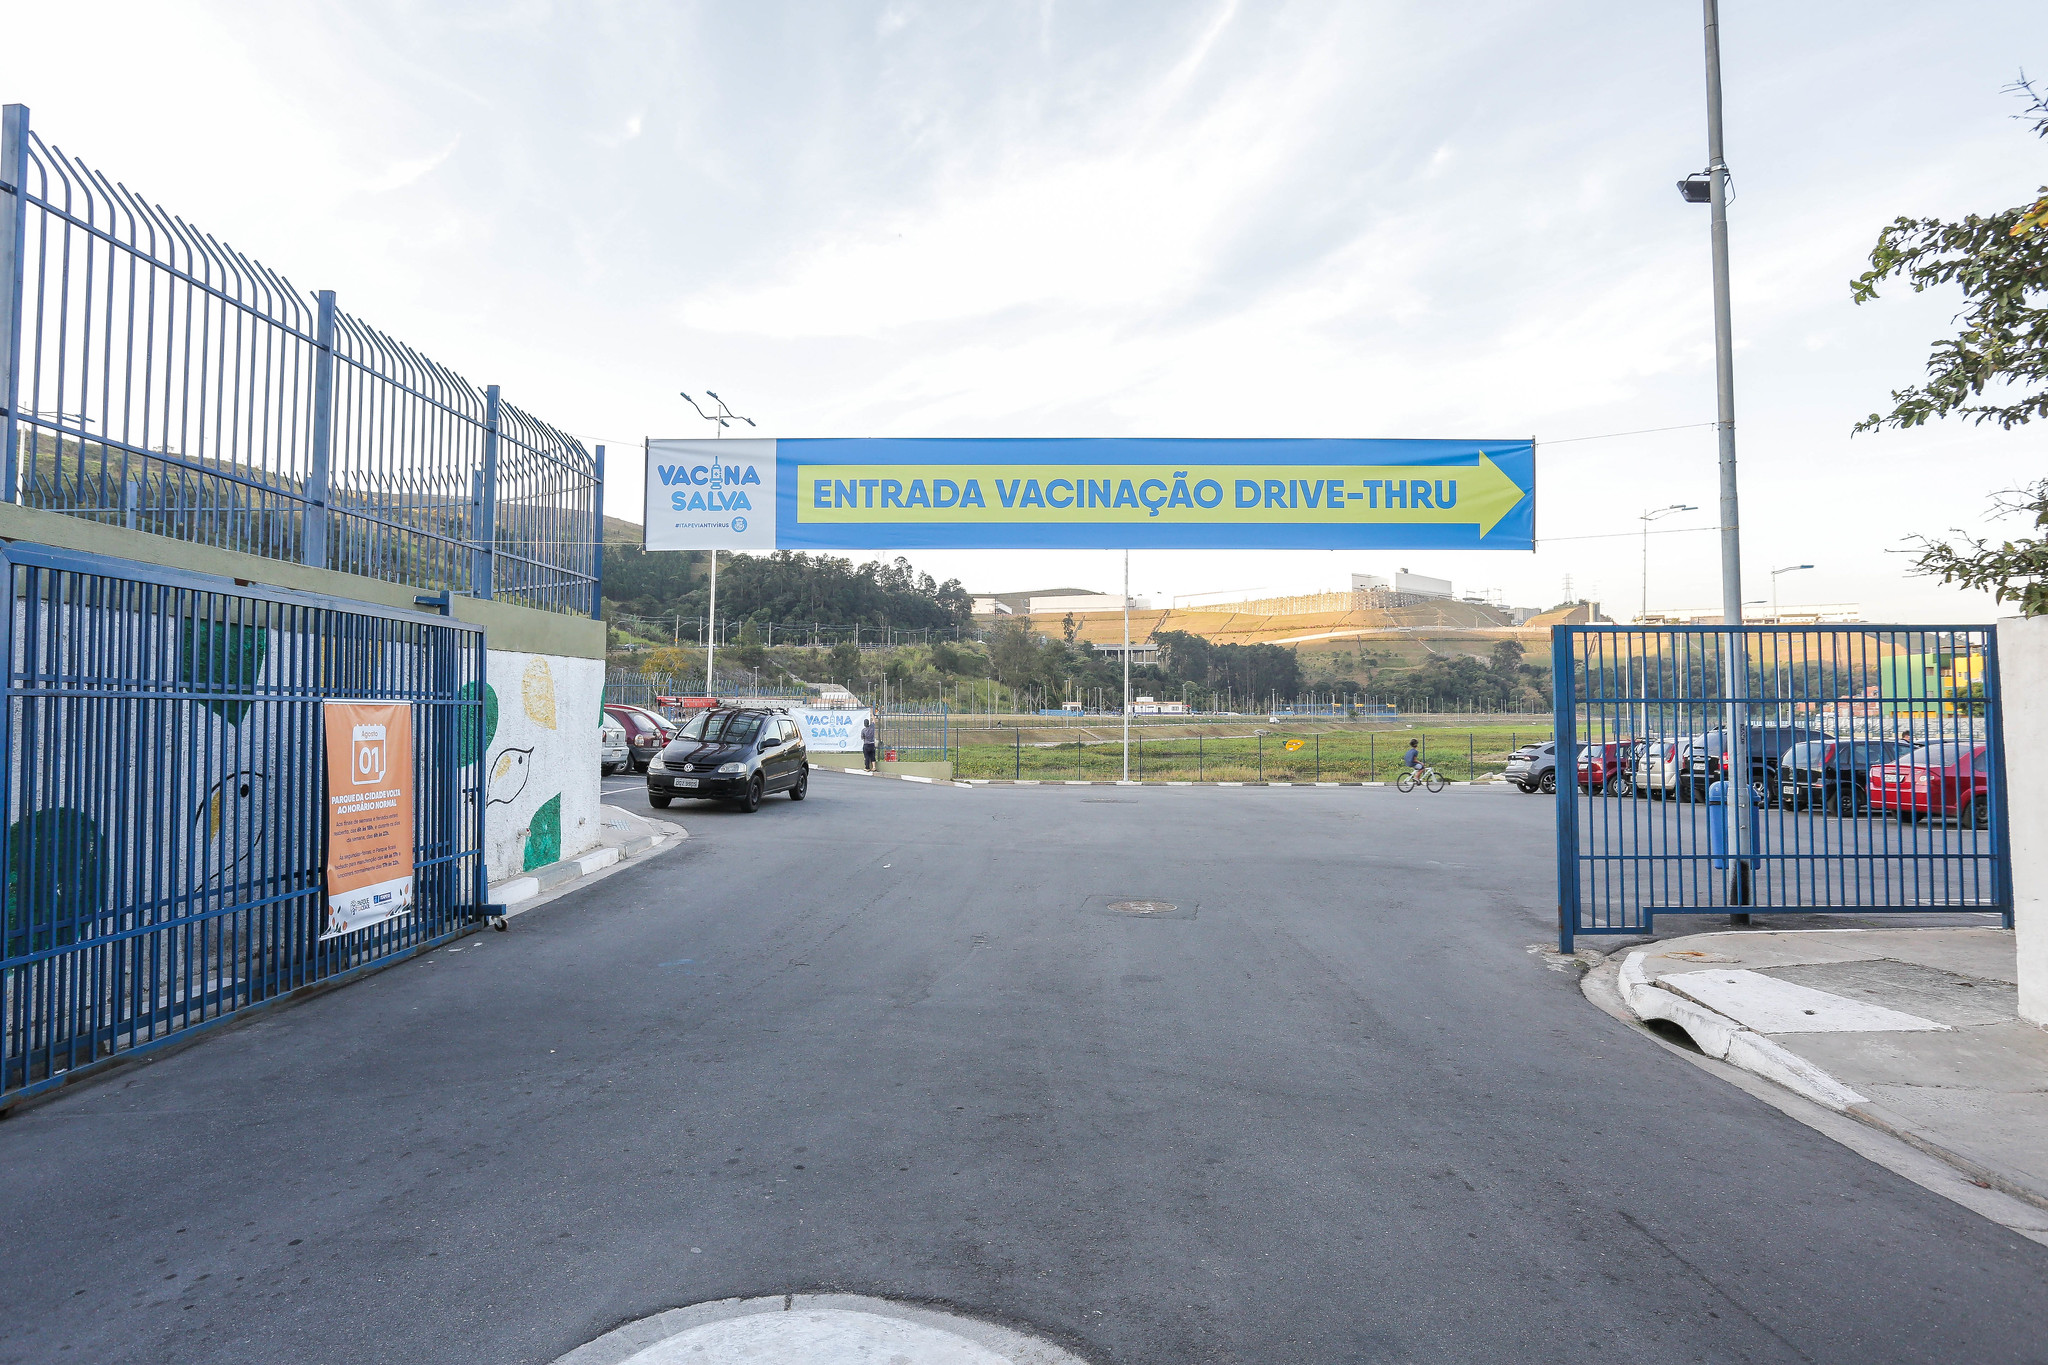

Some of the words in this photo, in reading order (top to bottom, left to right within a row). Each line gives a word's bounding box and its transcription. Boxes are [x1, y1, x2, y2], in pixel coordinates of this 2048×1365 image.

[671, 490, 752, 512] SALVA
[813, 478, 986, 509] ENTRADA
[994, 470, 1224, 517] VACINAÇÃO
[1234, 479, 1457, 510] DRIVE-THRU
[361, 731, 378, 739] Agosto
[811, 728, 848, 738] SALVA
[359, 747, 379, 774] 01
[332, 794, 356, 804] PARQUE
[356, 793, 364, 801] DA
[364, 791, 386, 800] CIDADE
[386, 789, 400, 797] VOLTA
[338, 805, 347, 814] AO
[348, 802, 374, 813] HORÁRIO
[375, 799, 397, 809] NORMAL
